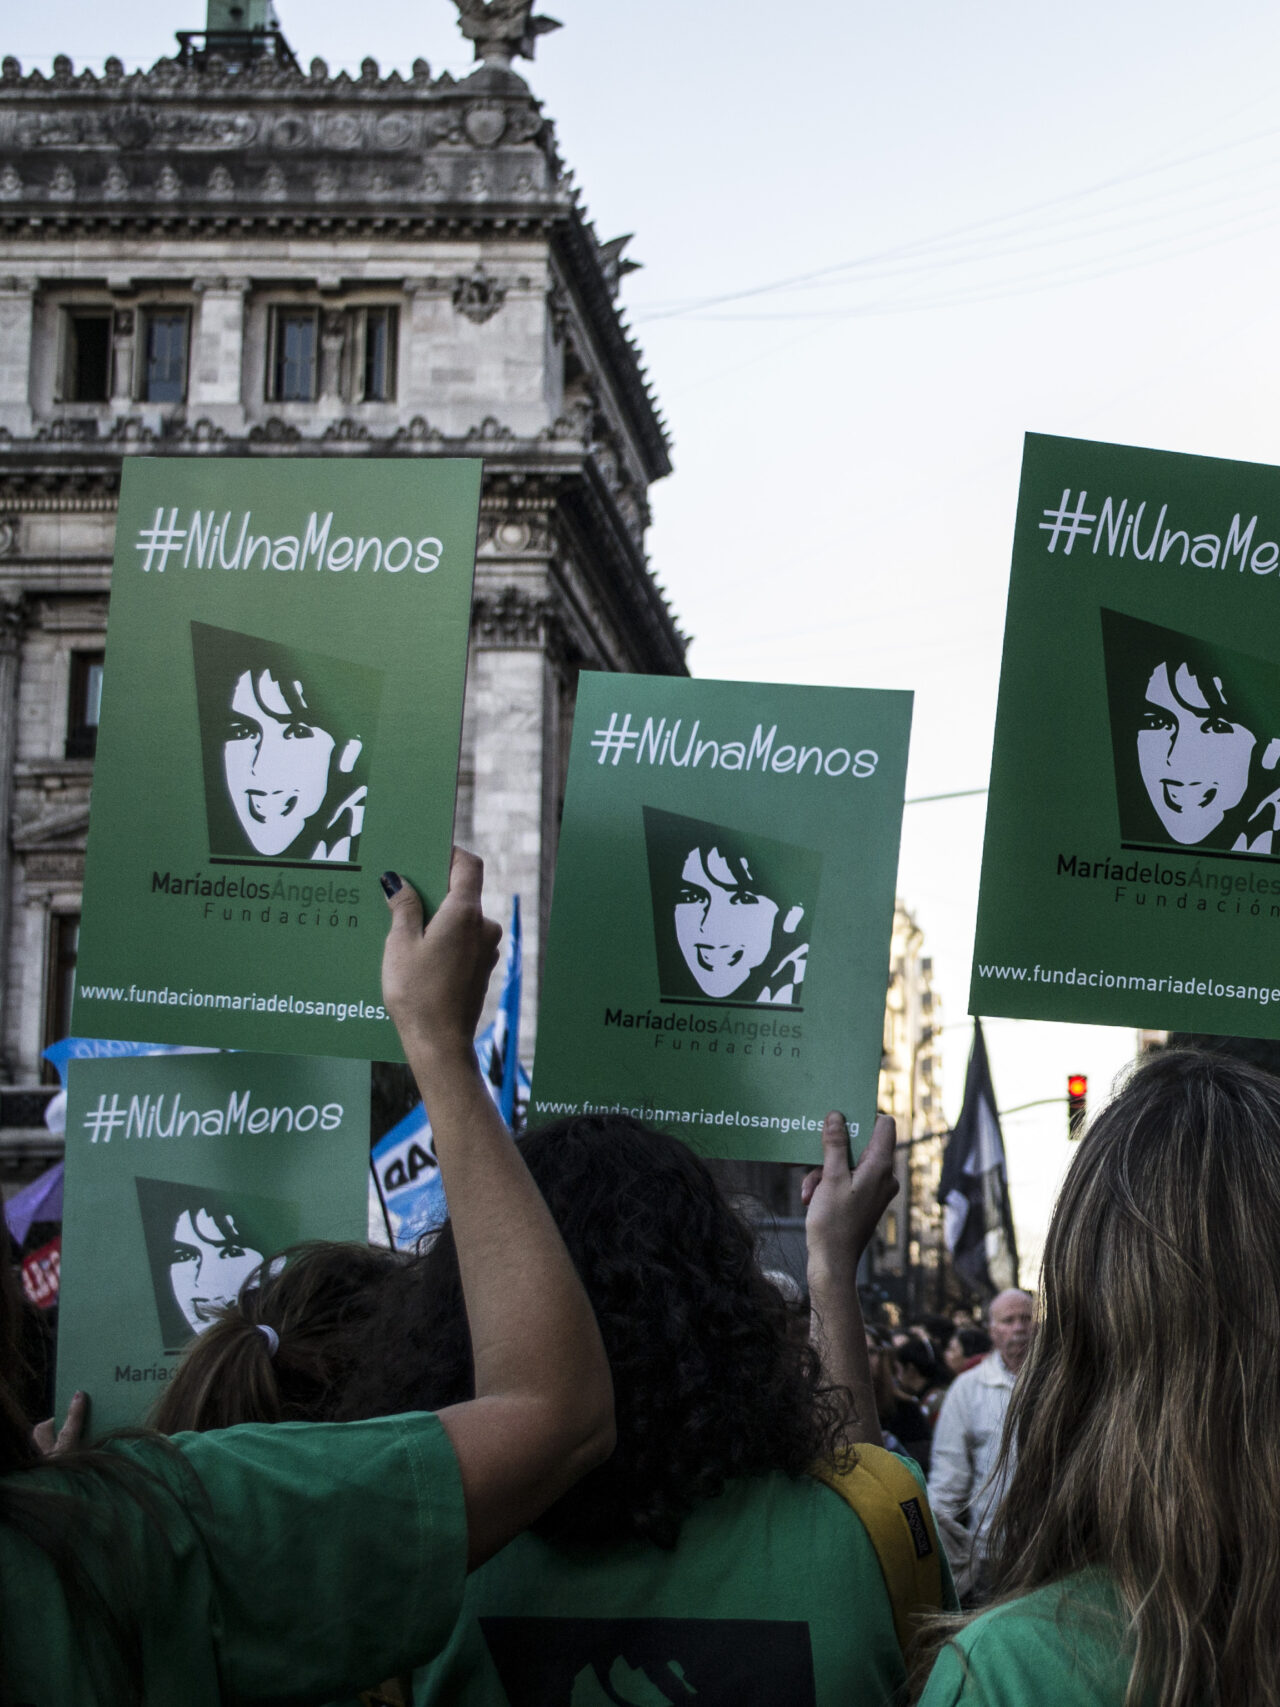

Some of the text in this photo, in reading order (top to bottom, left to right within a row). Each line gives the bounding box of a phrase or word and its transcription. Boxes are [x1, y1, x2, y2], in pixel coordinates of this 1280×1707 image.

[135, 507, 443, 572] #NiUnaMenos
[590, 712, 878, 778] #NiUnaMenos
[203, 902, 359, 928] Fundación
[1114, 886, 1280, 918] Fundación
[80, 984, 390, 1021] www.fundacionmariadelosangeles.
[654, 1034, 801, 1058] Fundación
[83, 1090, 344, 1143] #NiUnaMenos
